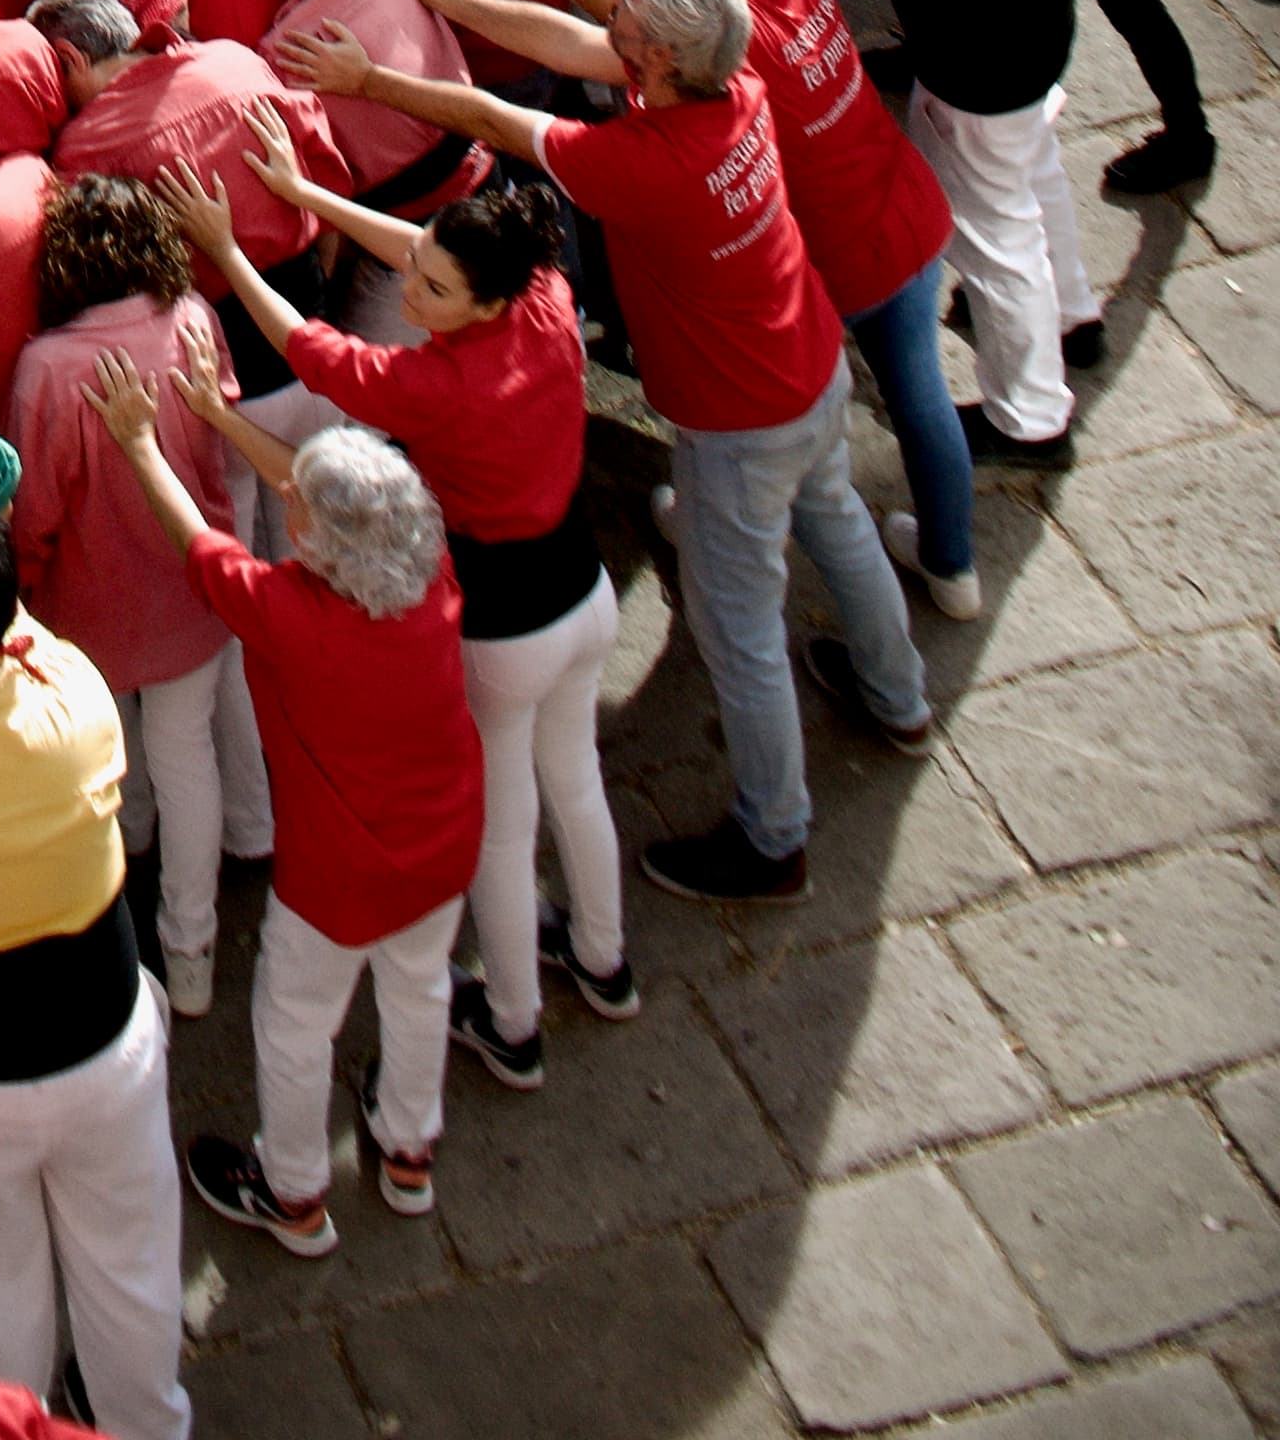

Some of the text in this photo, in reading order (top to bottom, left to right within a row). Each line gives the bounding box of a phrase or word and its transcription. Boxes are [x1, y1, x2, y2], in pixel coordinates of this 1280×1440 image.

[801, 62, 827, 92] fer
[706, 128, 760, 196] nascuts
[722, 183, 749, 218] fer
